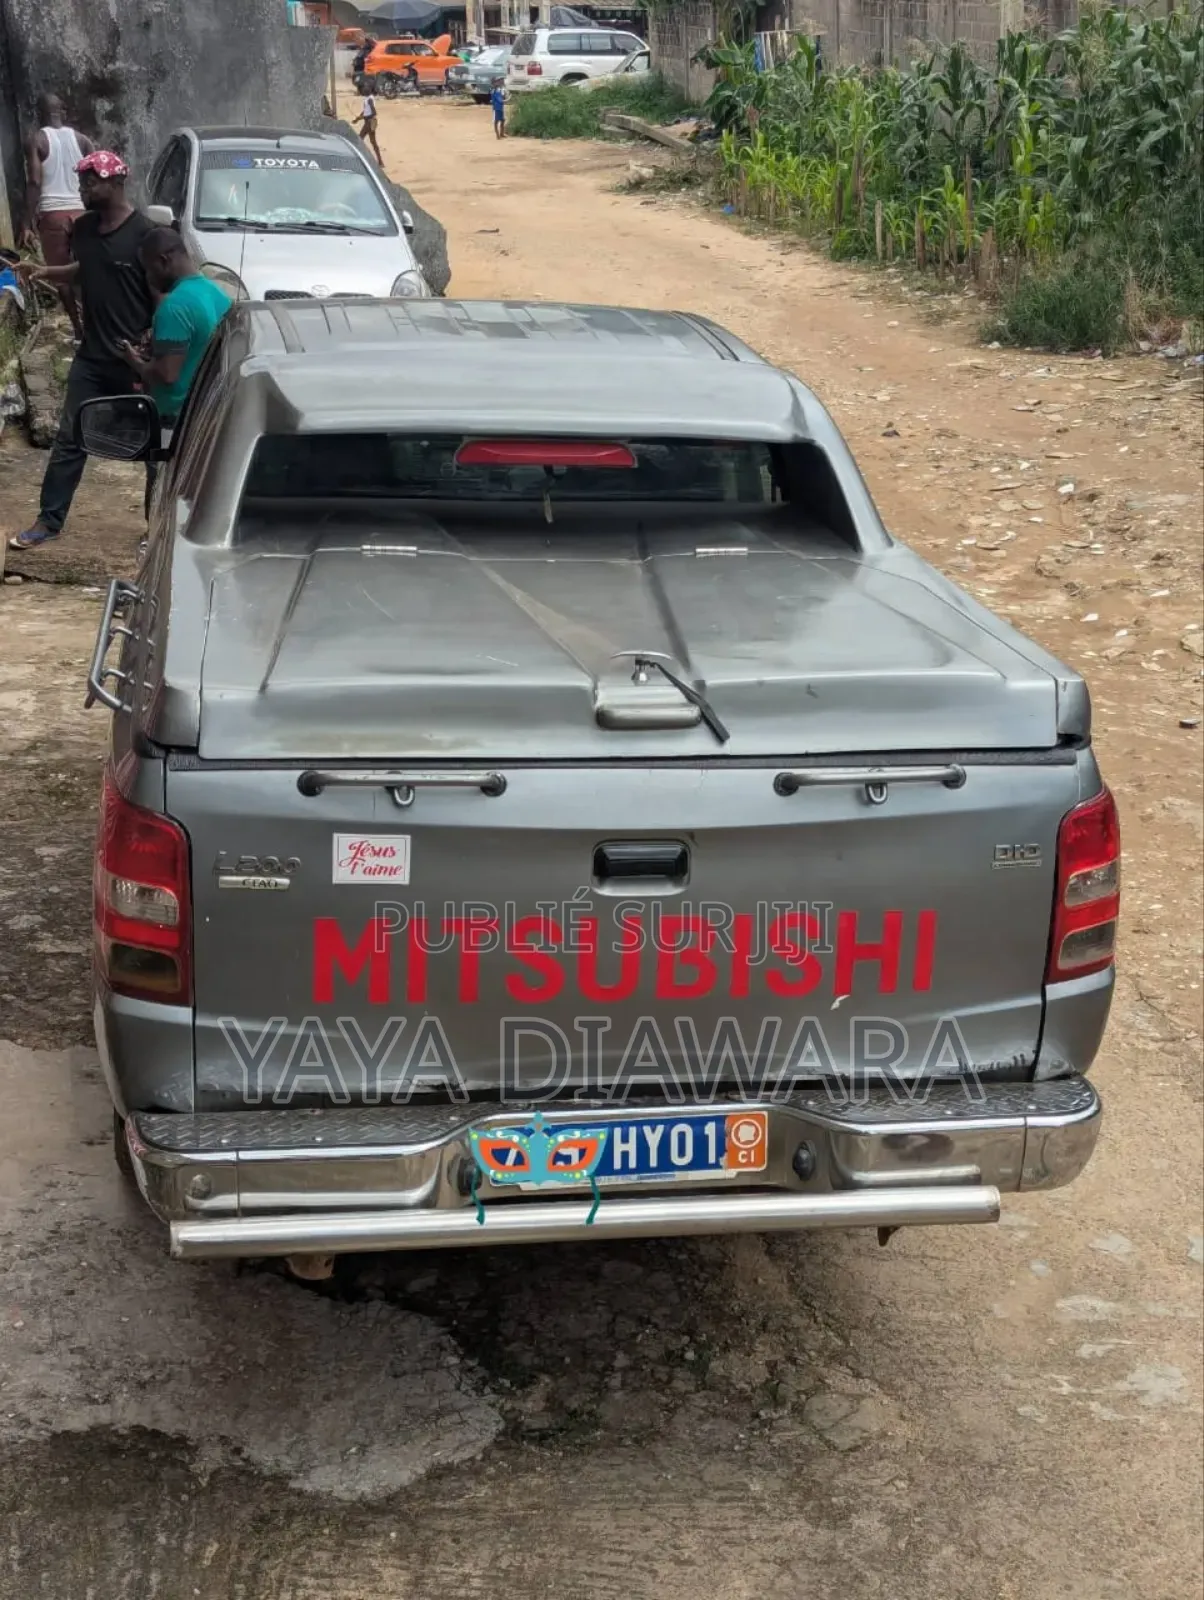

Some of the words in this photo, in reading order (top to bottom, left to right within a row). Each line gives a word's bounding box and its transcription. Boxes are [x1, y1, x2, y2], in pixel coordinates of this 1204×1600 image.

[254, 158, 320, 170] TOYOTA
[339, 840, 396, 867] Jésus
[312, 908, 938, 1004] MITSUBISHI
[738, 1150, 756, 1164] CI
